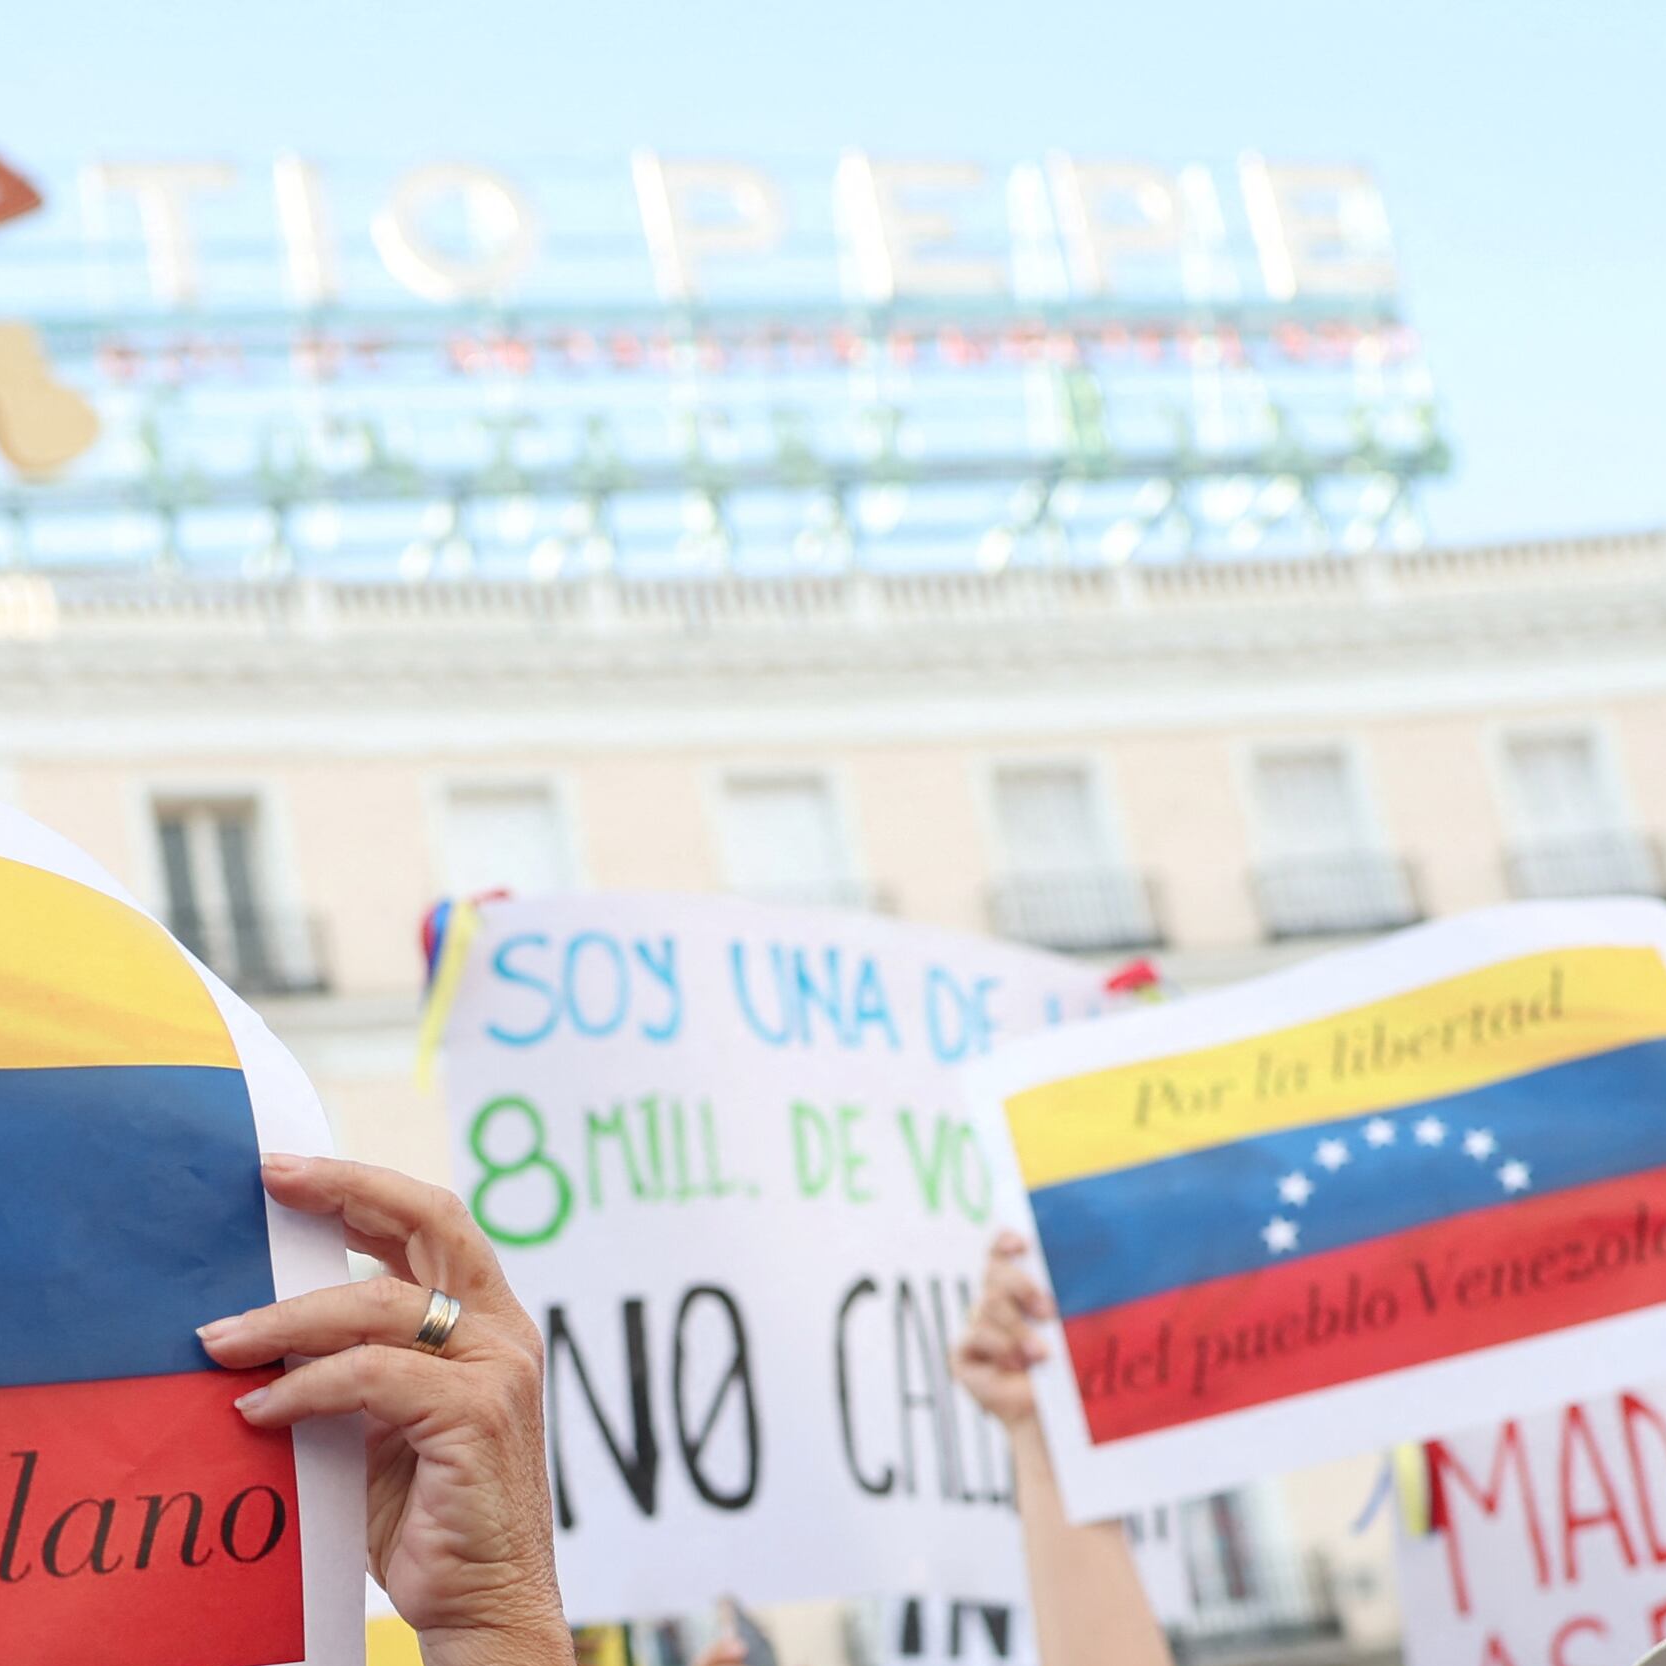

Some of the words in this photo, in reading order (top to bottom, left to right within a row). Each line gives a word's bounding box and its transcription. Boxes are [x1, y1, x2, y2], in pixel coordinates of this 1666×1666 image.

[95, 152, 533, 308] TIO
[631, 150, 1388, 302] PEPE
[483, 929, 686, 1047] SOY
[728, 937, 903, 1051] UNA
[1133, 1075, 1235, 1129] Por
[1255, 1053, 1309, 1102] la
[1330, 968, 1566, 1083] libertad
[467, 1092, 574, 1247] 8
[788, 1096, 876, 1204] DE
[1084, 1333, 1173, 1401] del
[1191, 1282, 1401, 1398] pueblo
